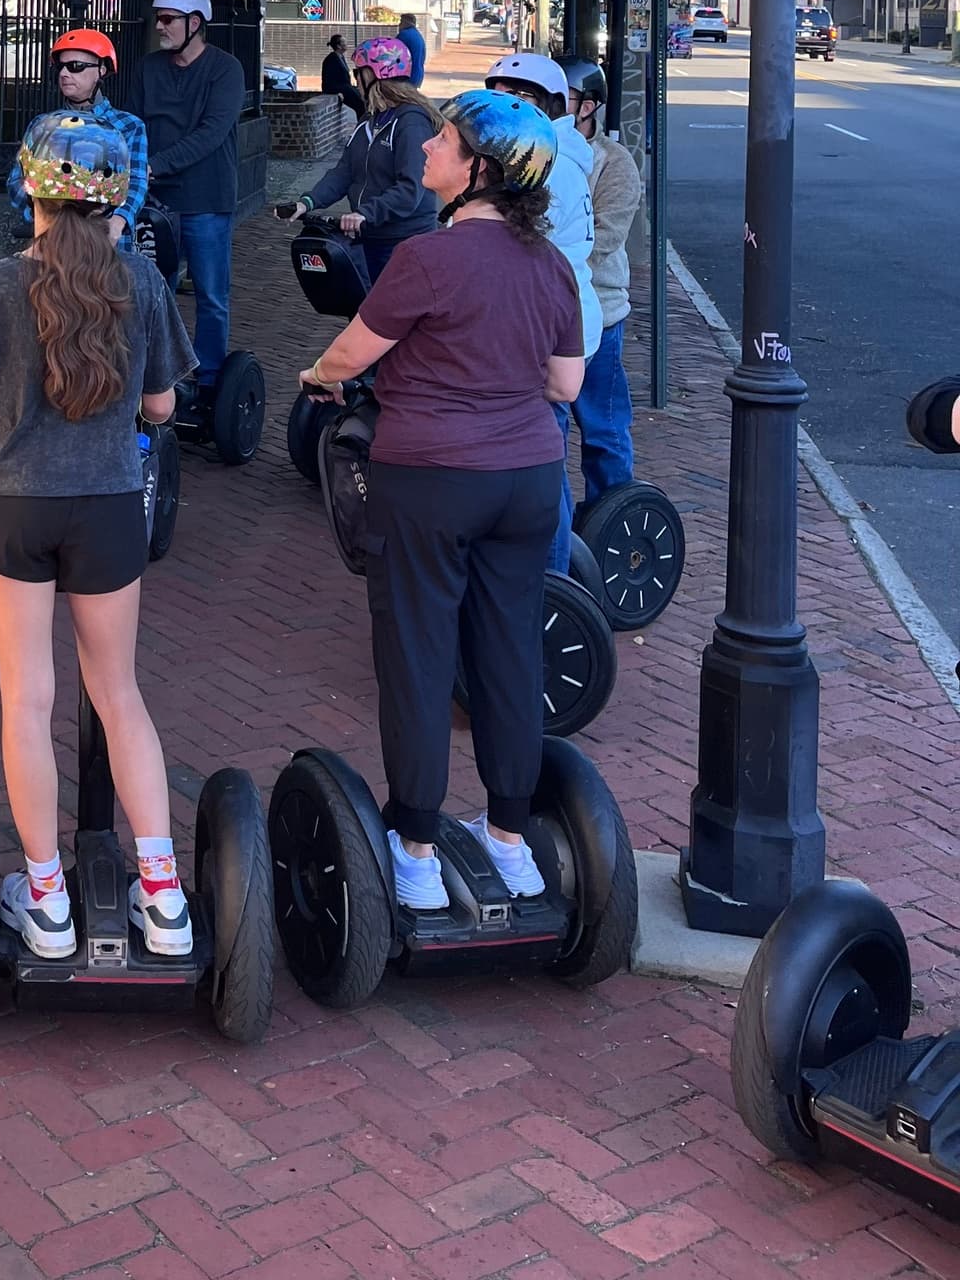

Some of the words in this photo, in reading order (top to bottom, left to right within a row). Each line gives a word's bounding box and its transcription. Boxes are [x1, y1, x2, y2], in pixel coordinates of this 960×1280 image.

[302, 6, 324, 15] OPEN
[302, 254, 325, 268] RVA
[350, 462, 367, 502] SEG
